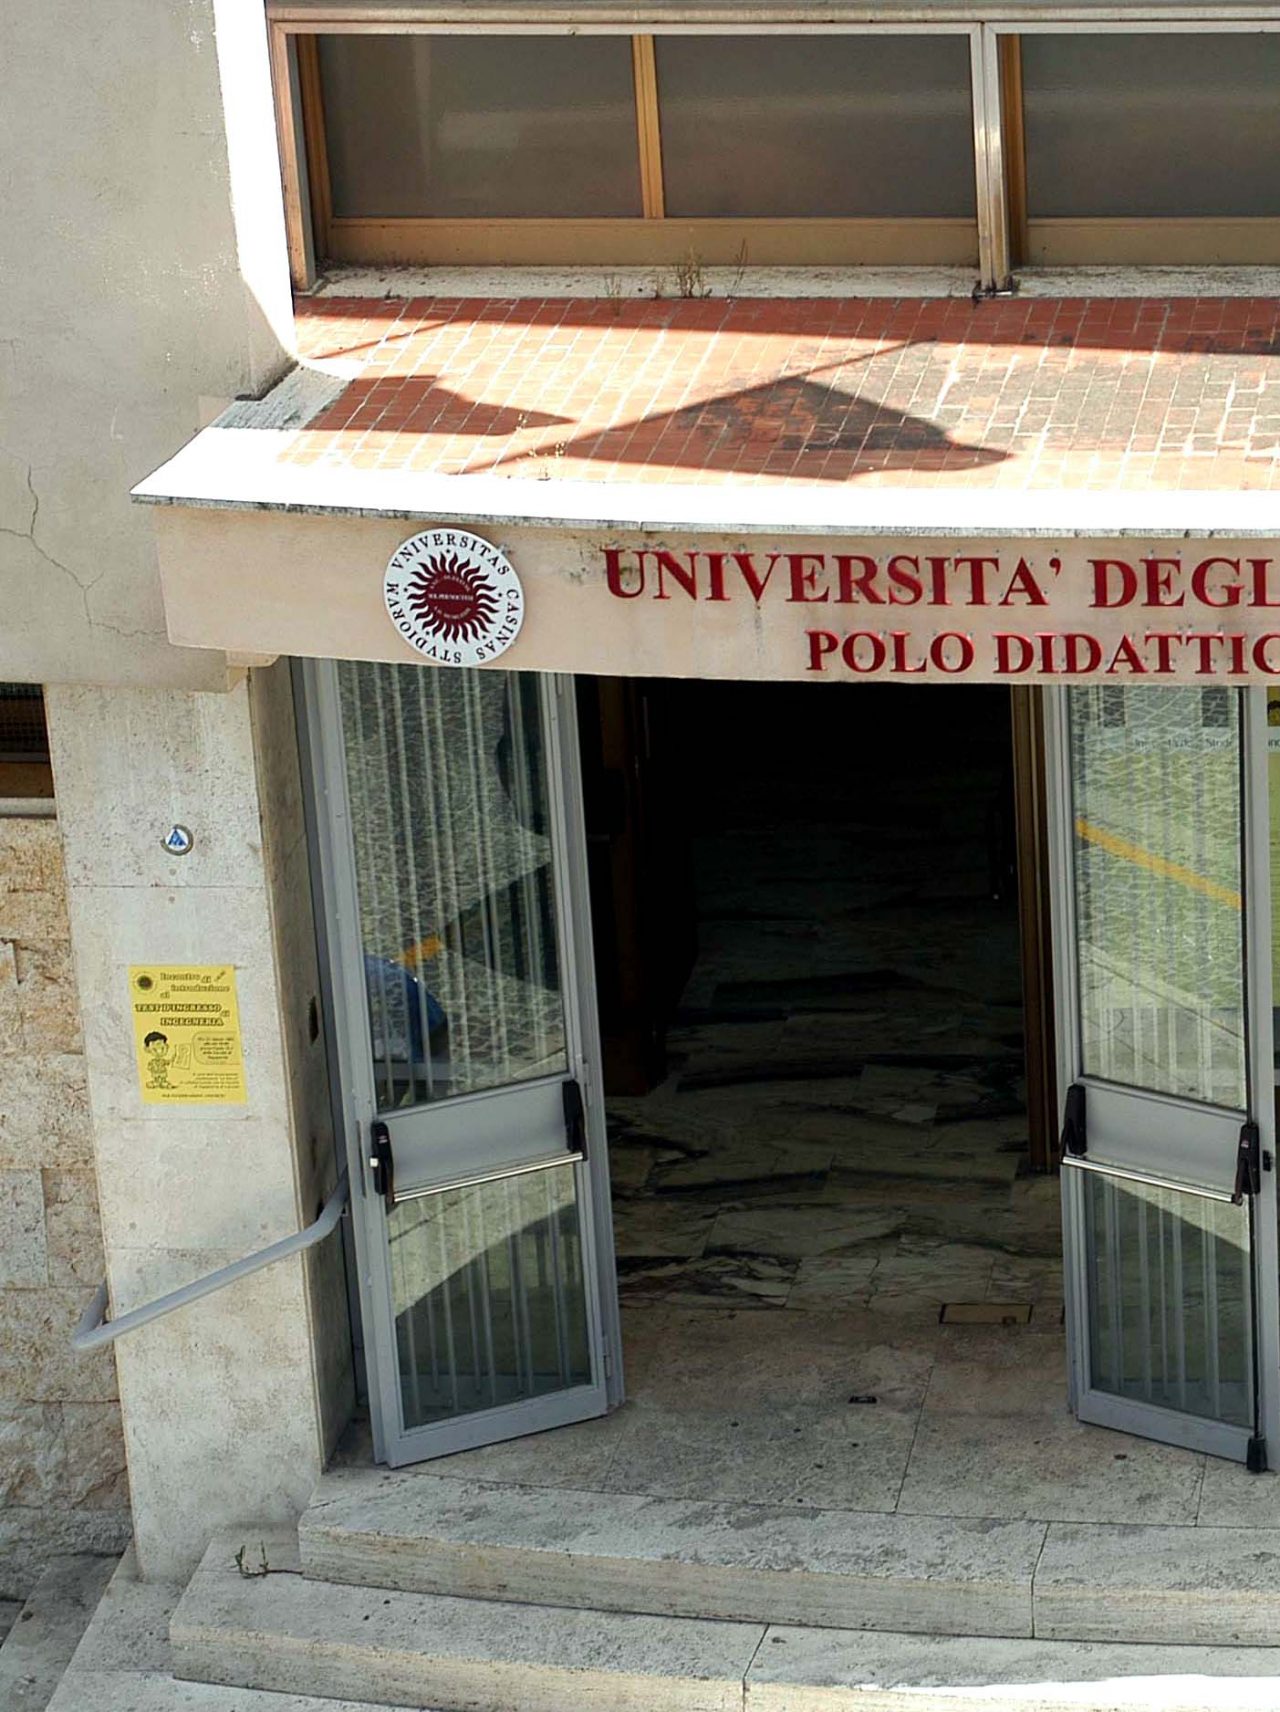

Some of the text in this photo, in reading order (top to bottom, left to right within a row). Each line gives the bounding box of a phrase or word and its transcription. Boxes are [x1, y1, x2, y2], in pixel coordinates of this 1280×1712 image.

[386, 533, 519, 664] VNIVERSITAS CASINAS STVDIORVM
[602, 548, 1062, 607] UNIVERSITA'
[805, 629, 976, 674] POLO
[135, 1003, 160, 1012] TEST
[160, 1017, 224, 1026] INGEGNERIA
